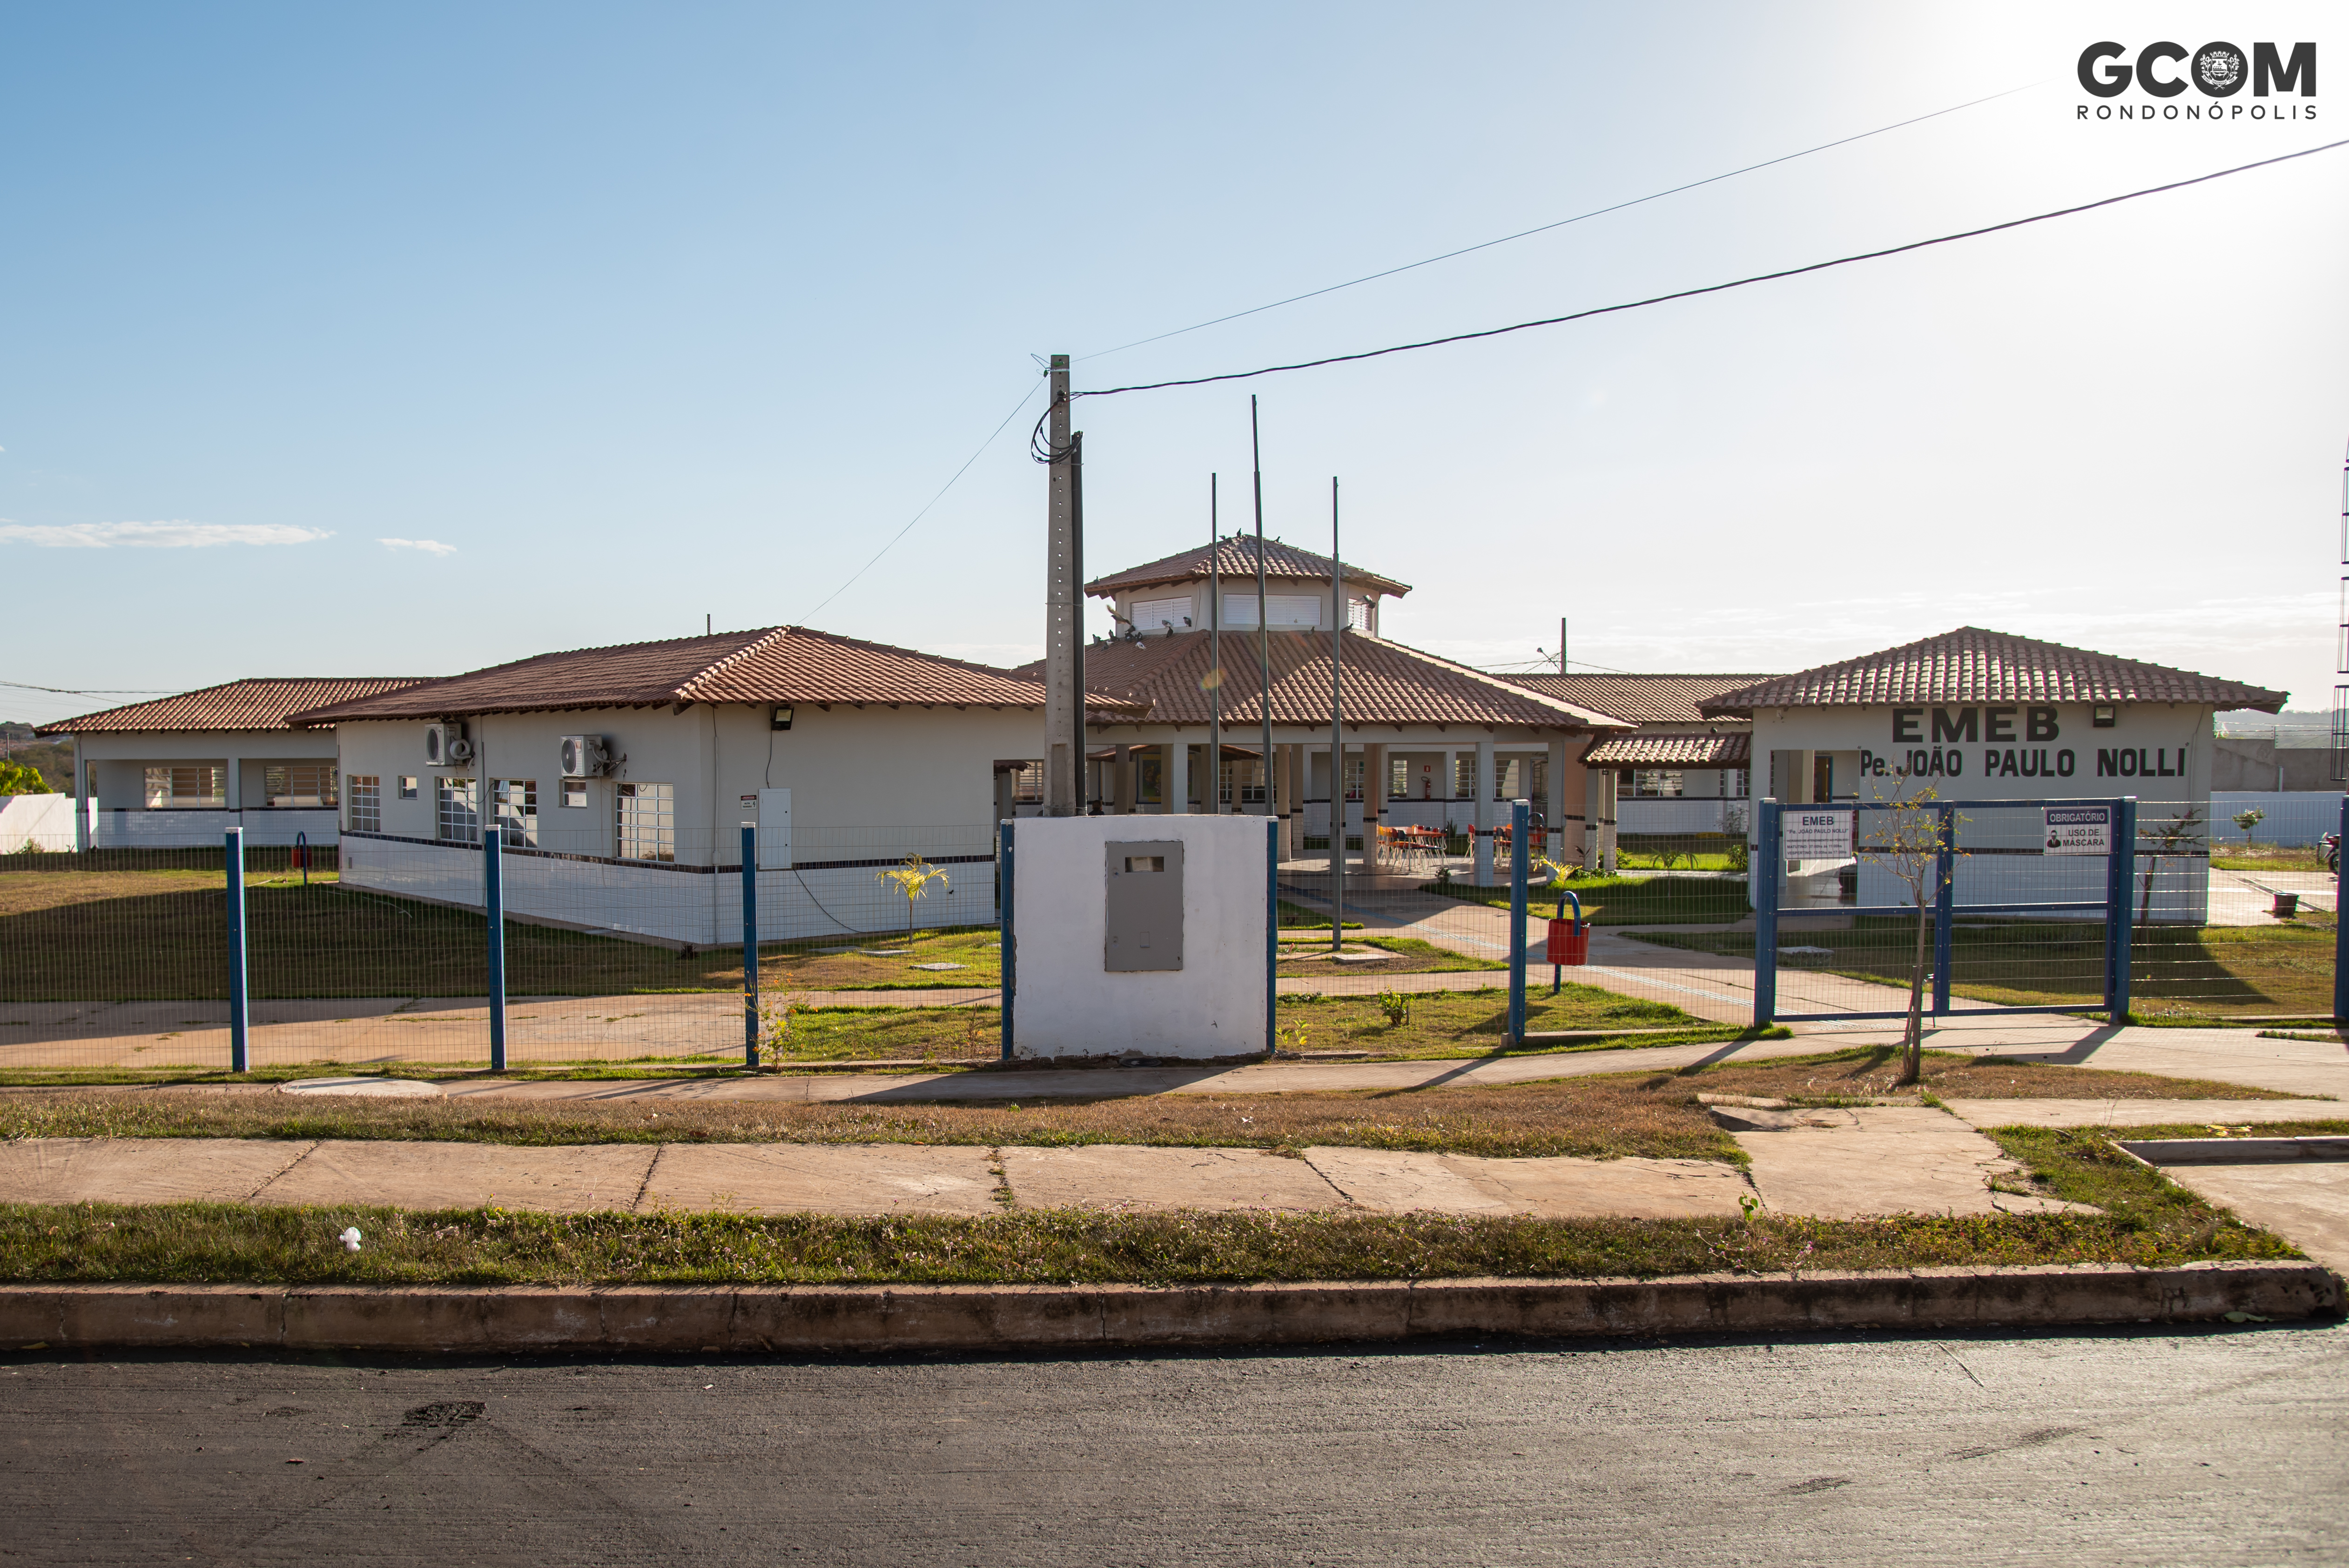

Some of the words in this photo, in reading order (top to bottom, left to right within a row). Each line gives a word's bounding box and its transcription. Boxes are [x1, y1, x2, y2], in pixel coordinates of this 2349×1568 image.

[1892, 706, 2060, 743] EMEB
[1896, 746, 1963, 777] JOÃO
[1985, 748, 2075, 777] PAULO
[1802, 816, 1834, 826] EMEB
[2050, 811, 2105, 822] OBRIGATÓRIO
[2062, 837, 2105, 847] MÁSCARA
